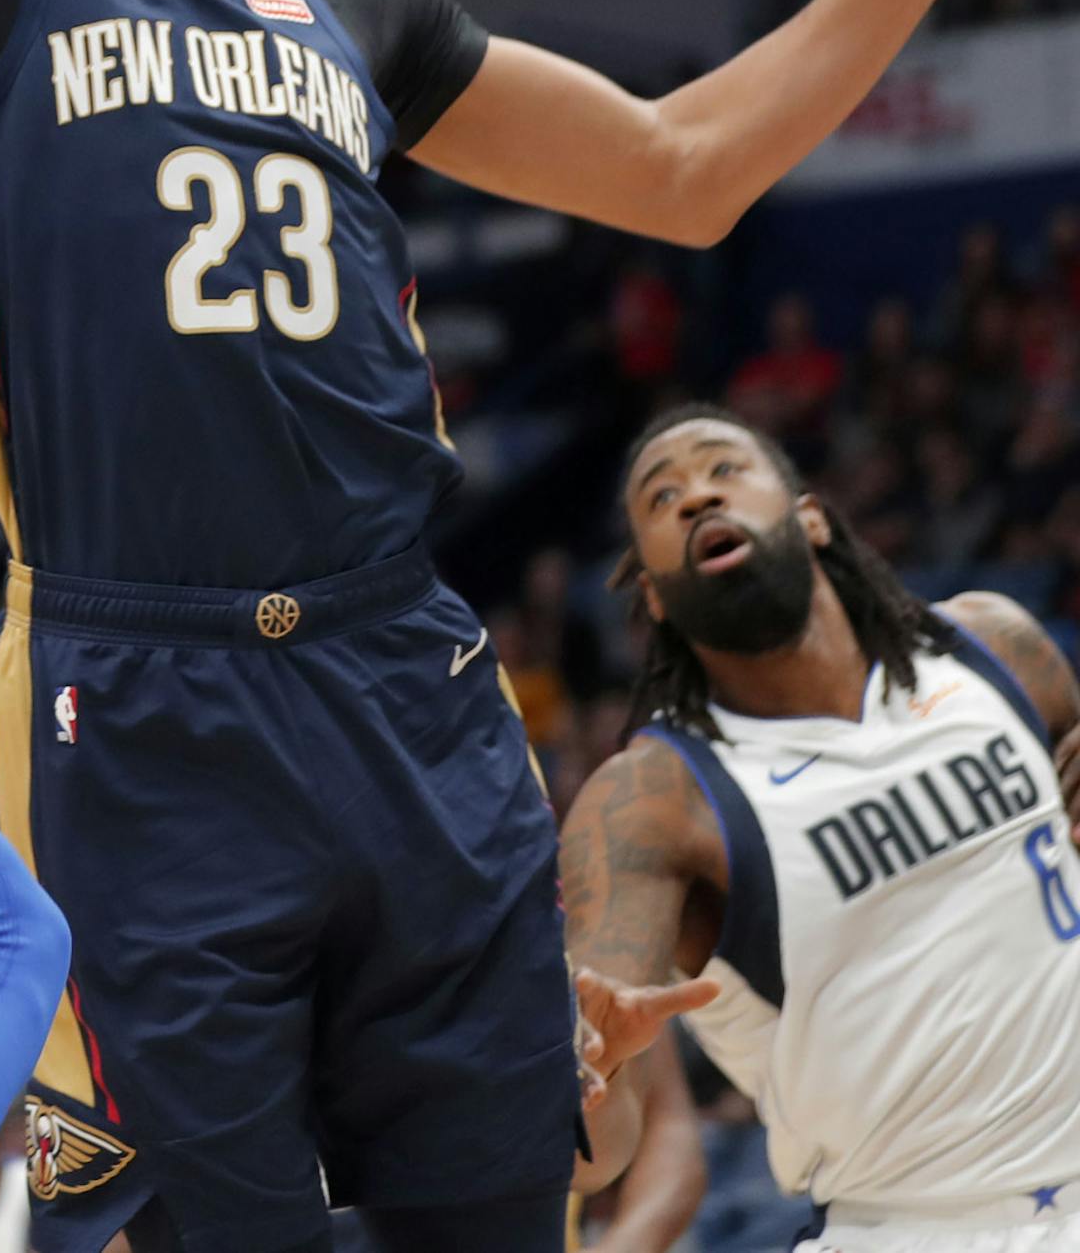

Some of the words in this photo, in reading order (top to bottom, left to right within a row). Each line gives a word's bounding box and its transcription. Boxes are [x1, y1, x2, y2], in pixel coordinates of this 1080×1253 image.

[48, 18, 173, 126] NEW
[185, 26, 369, 175] ORLEANS
[156, 146, 340, 342] 23
[804, 732, 1039, 901] DALLAS
[1024, 820, 1080, 942] 6
